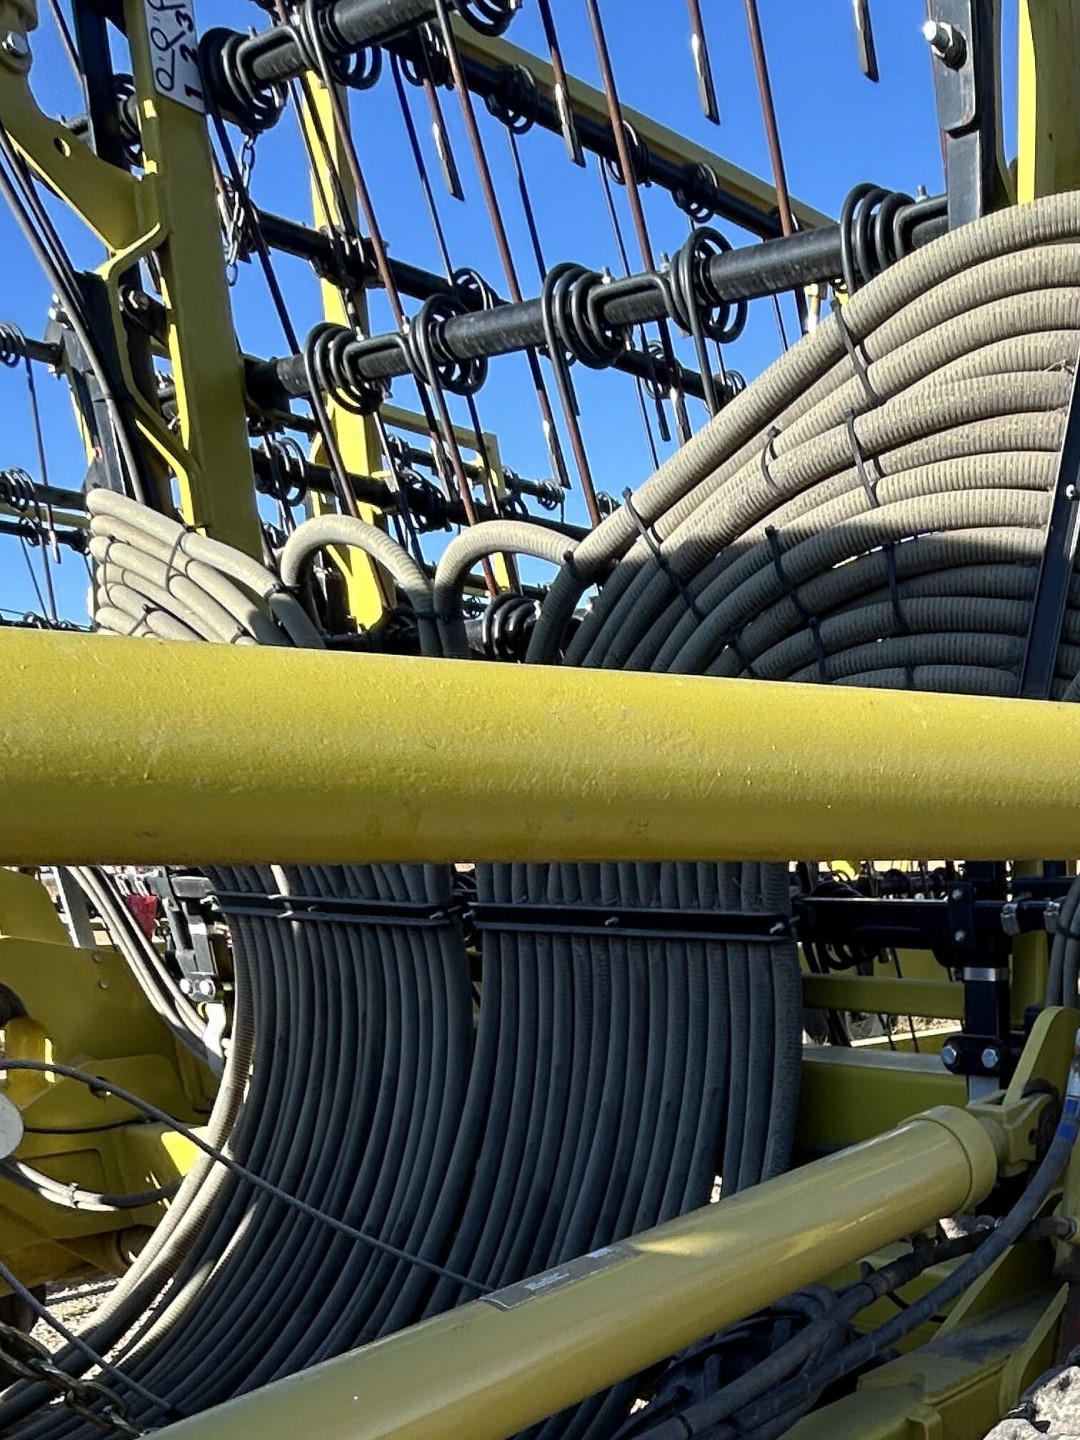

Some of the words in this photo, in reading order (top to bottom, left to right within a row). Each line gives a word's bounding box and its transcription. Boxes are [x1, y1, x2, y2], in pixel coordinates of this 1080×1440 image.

[175, 9, 194, 32] 3
[180, 44, 200, 65] 2
[184, 83, 203, 99] 1
